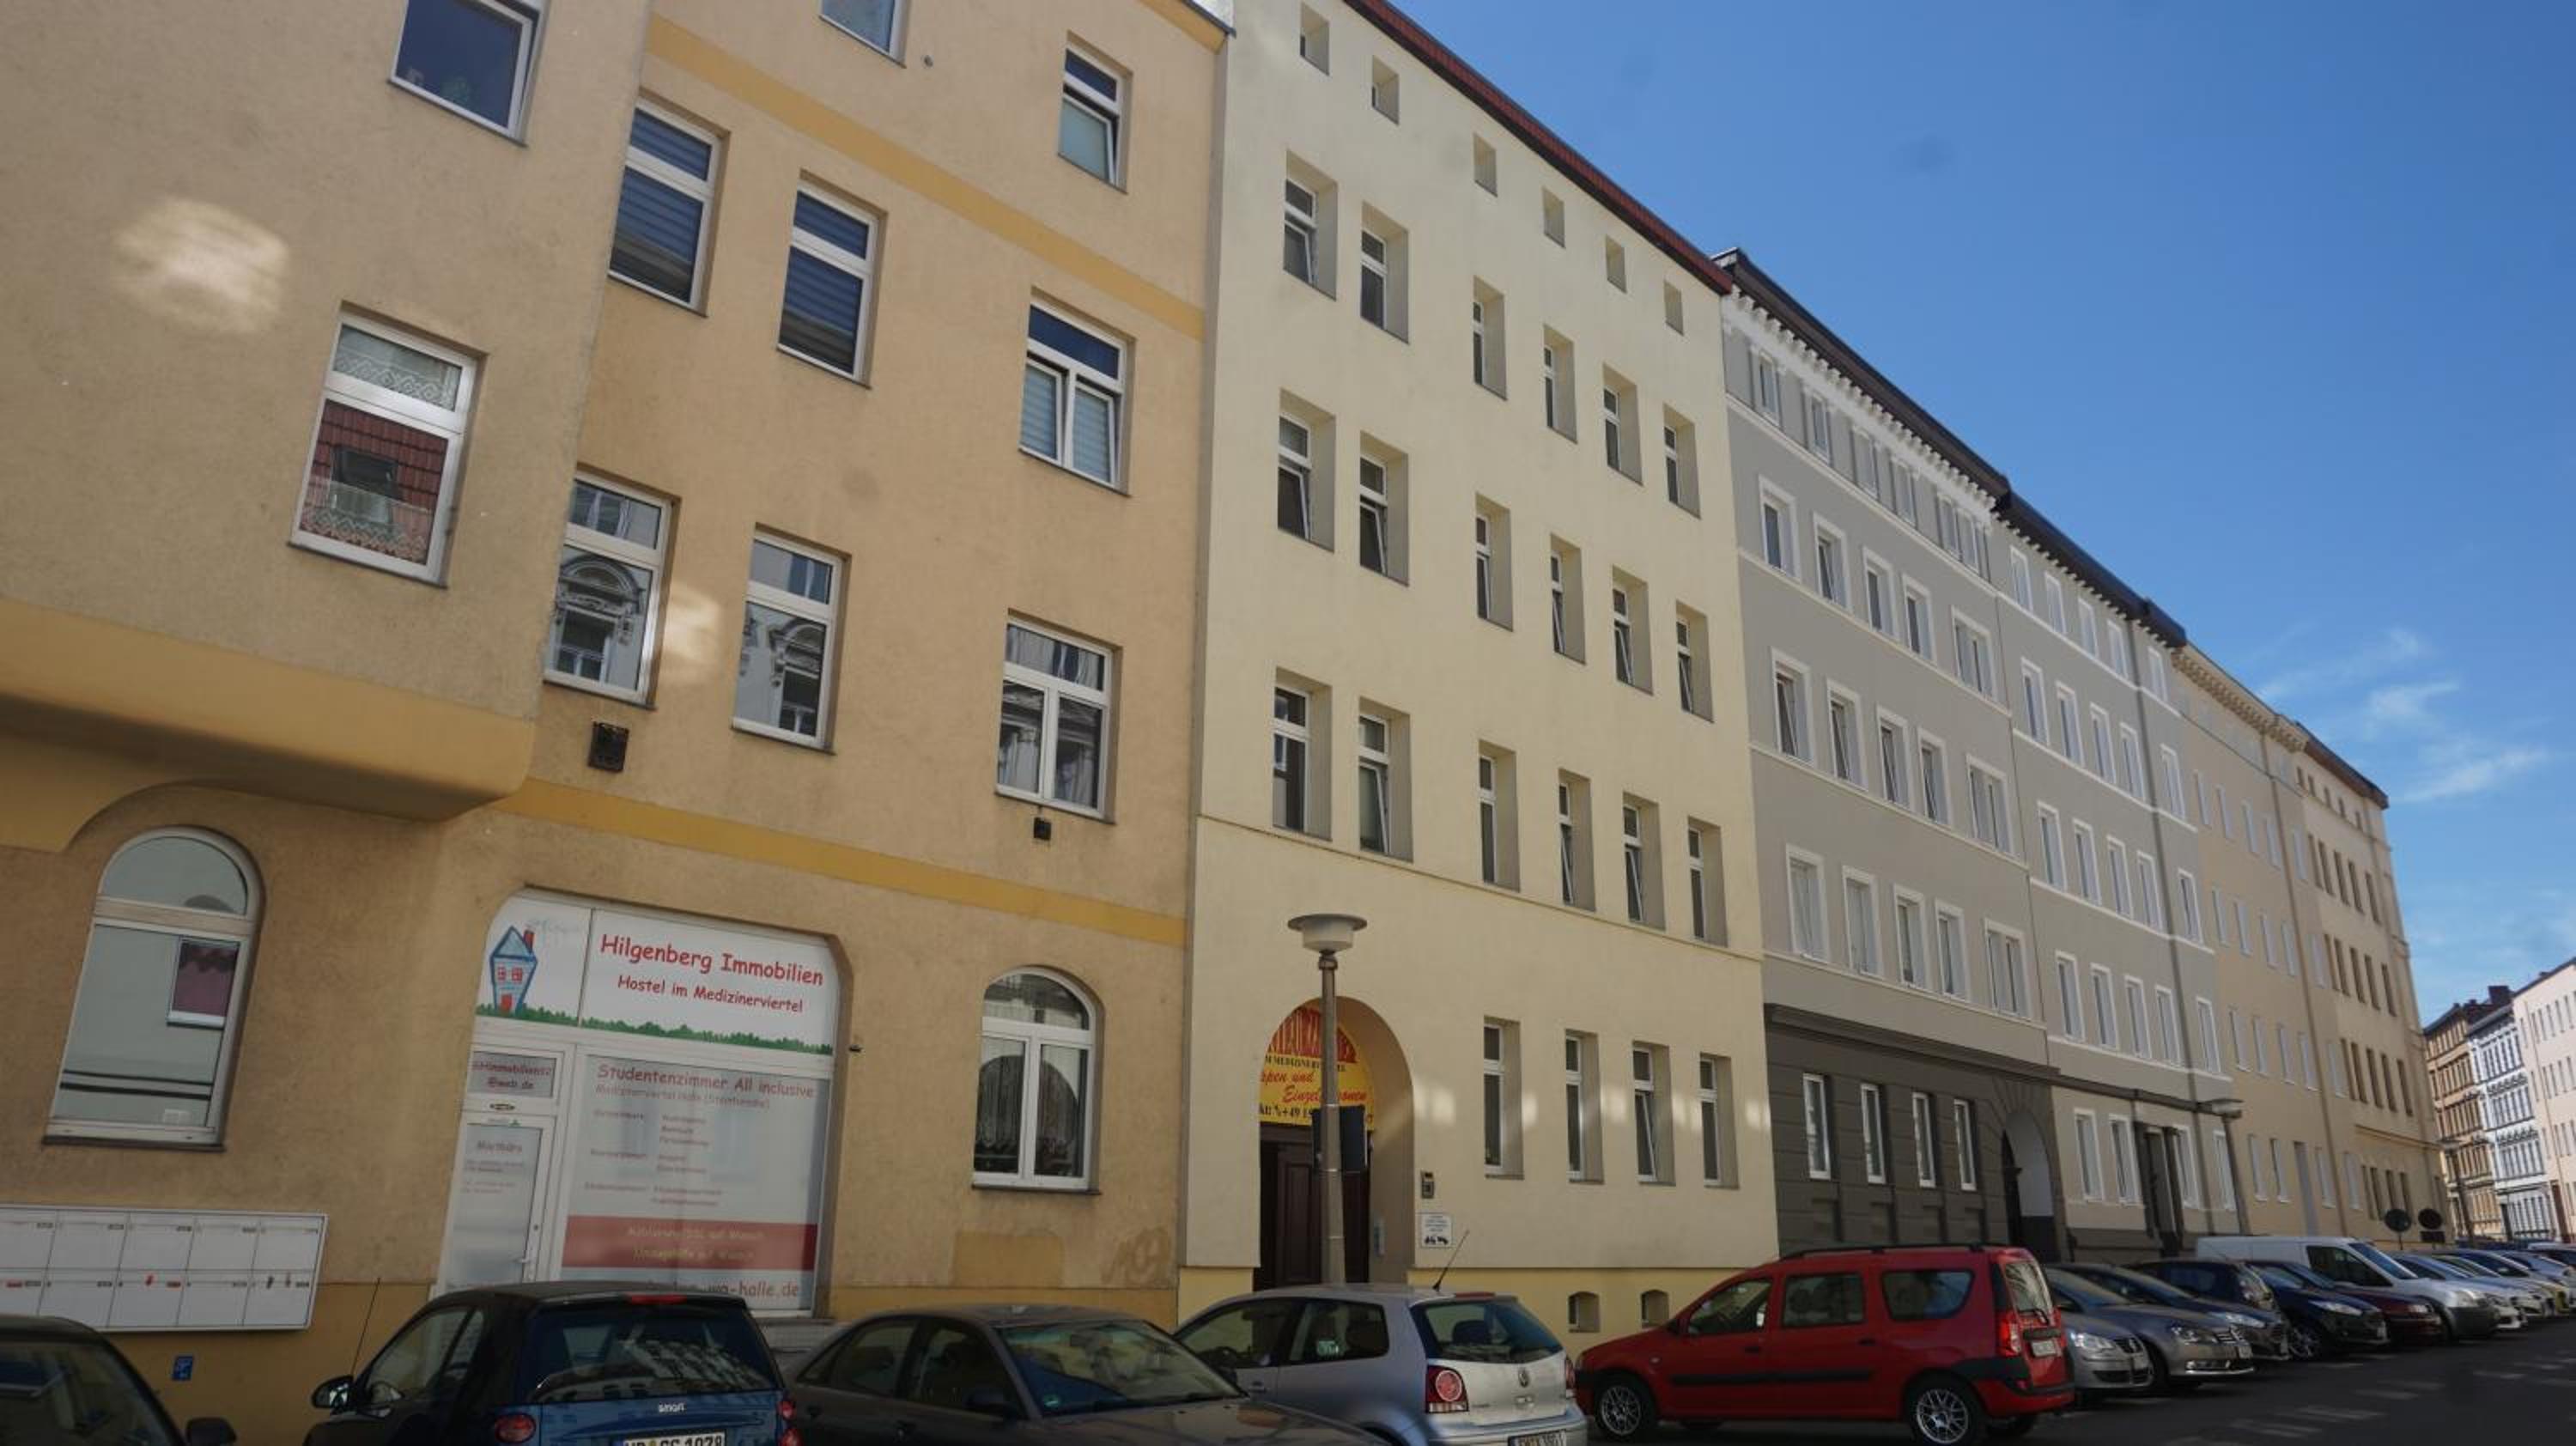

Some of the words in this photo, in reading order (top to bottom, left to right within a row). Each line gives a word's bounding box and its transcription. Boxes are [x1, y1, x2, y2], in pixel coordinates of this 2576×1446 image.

[600, 933, 713, 974] Hilgenberg
[720, 953, 824, 986] Immobilien
[617, 975, 665, 993] Hostel
[671, 982, 688, 997] im
[693, 985, 803, 1012] Medizinerviertel
[598, 1063, 728, 1090] Studentenzimmer
[735, 1077, 752, 1093] All
[759, 1080, 814, 1099] inclusive
